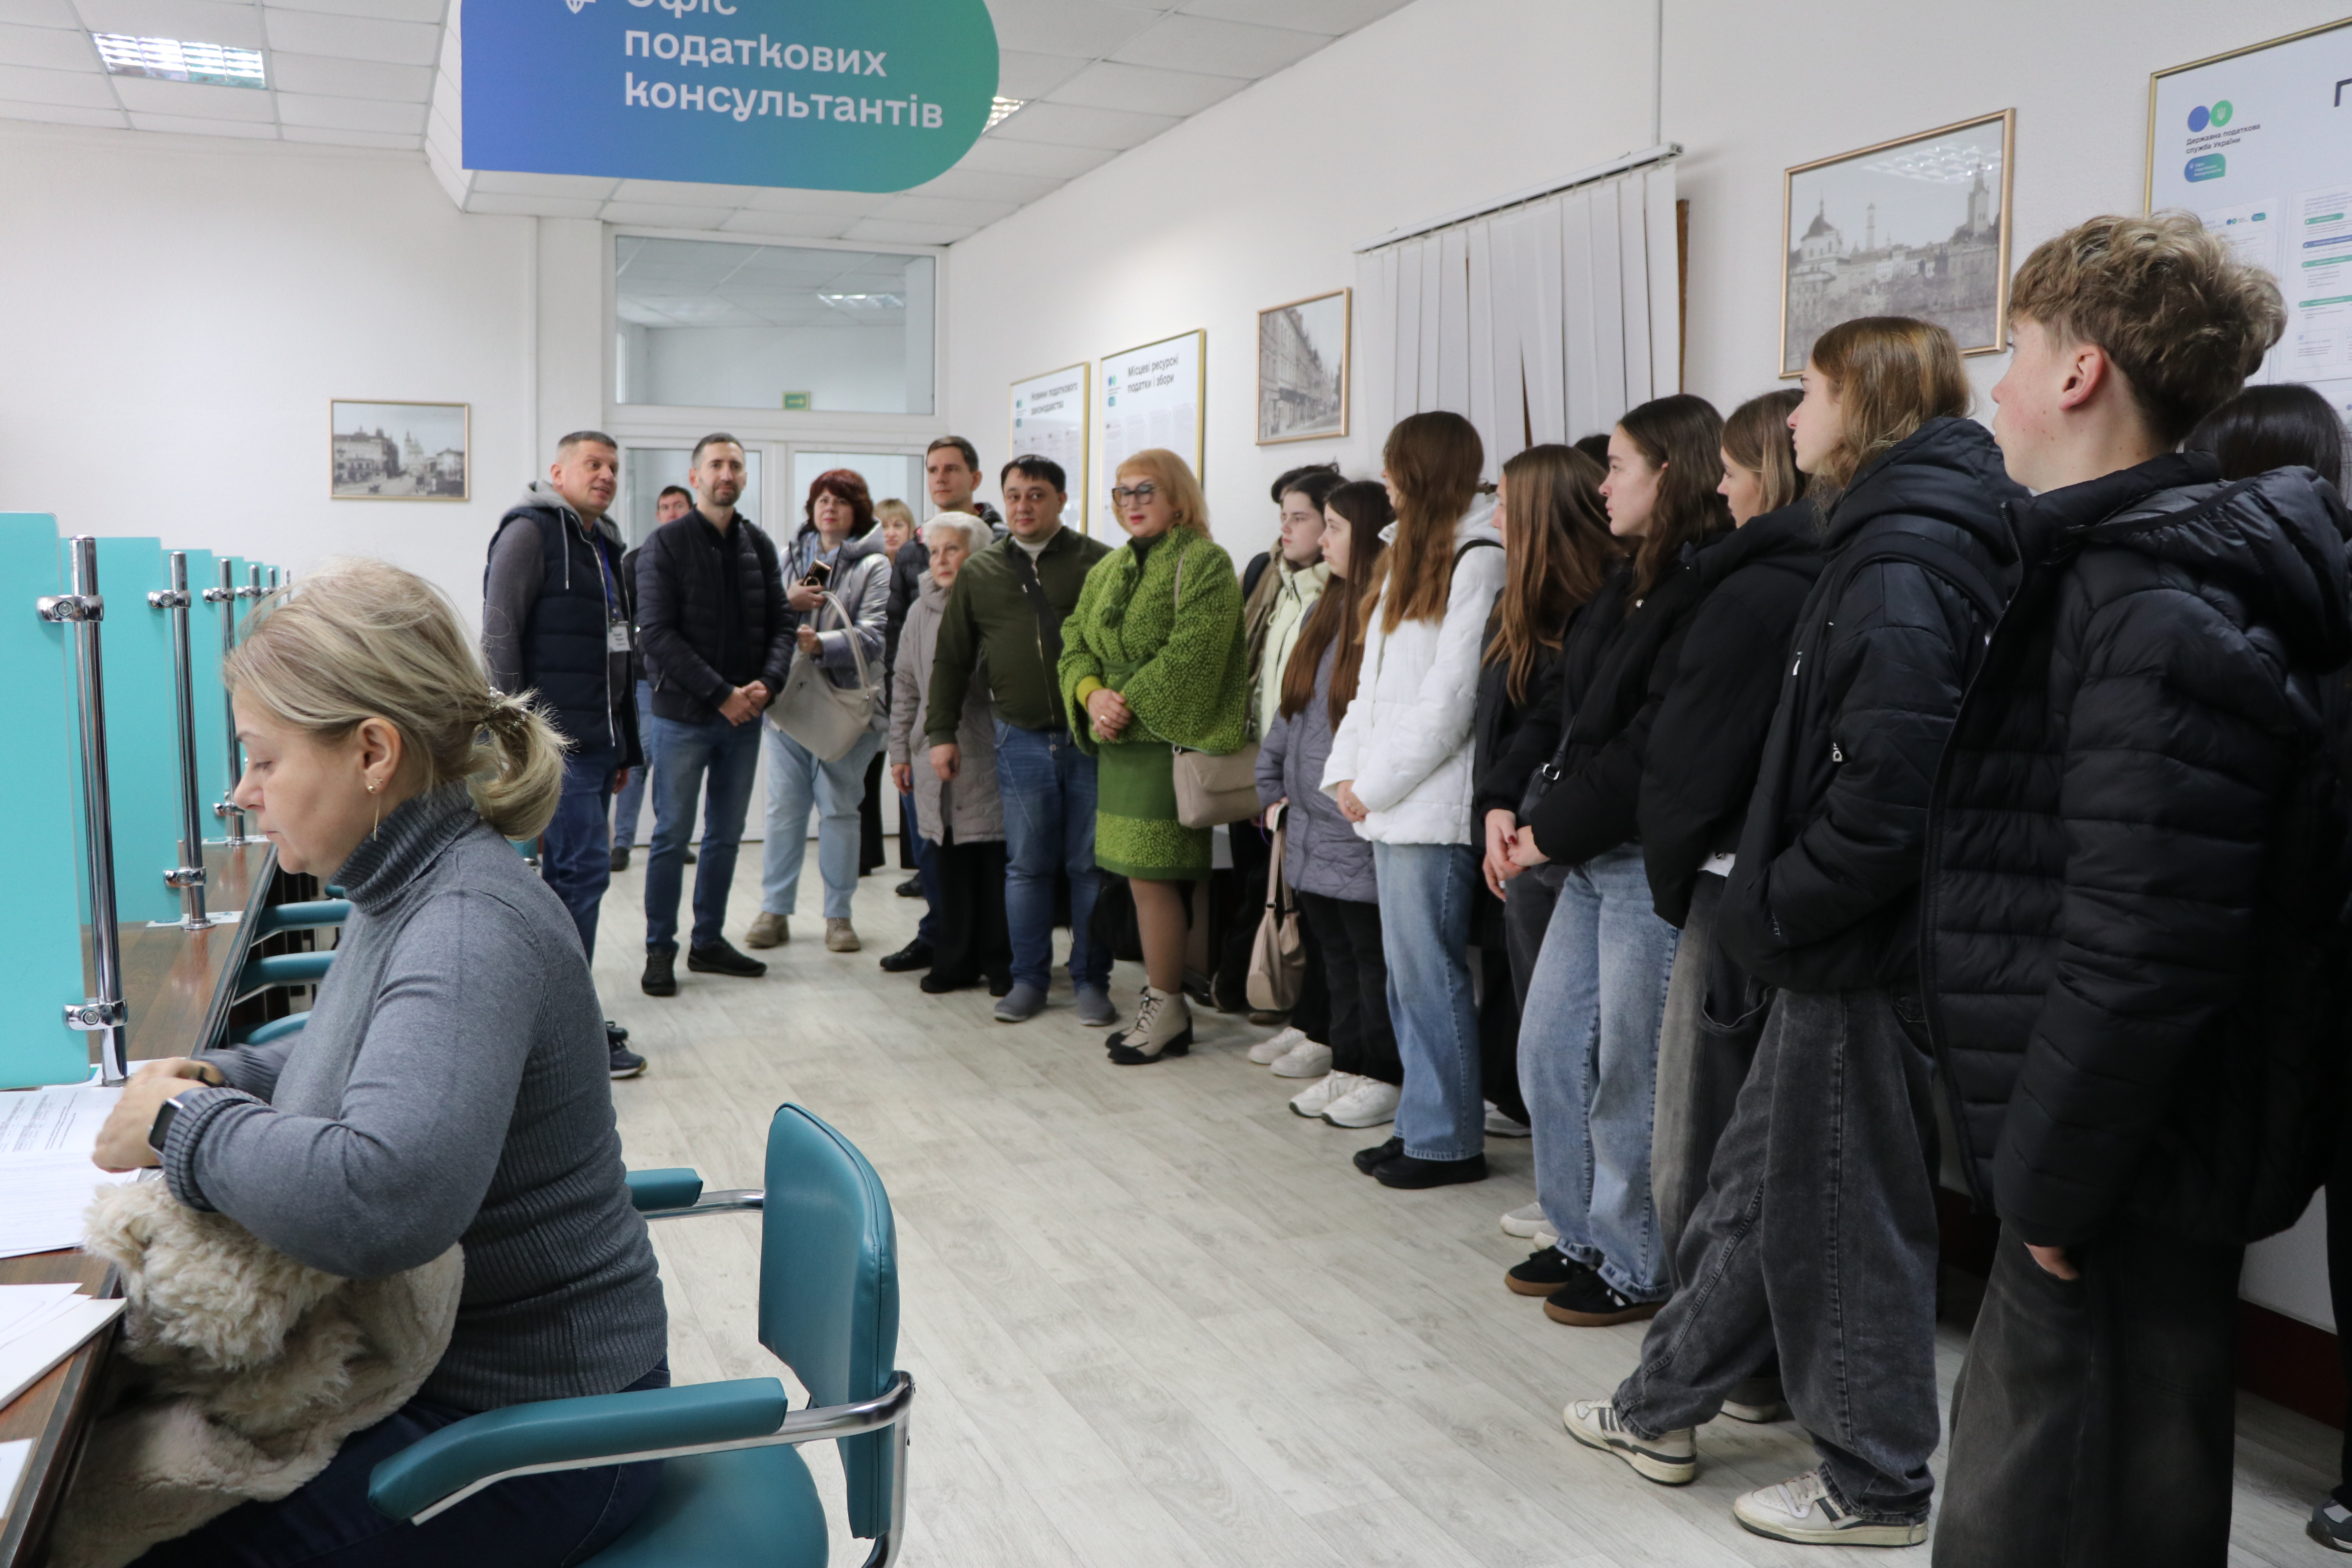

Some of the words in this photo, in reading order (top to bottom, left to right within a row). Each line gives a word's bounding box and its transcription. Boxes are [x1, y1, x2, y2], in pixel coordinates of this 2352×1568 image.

[626, 29, 887, 78] податкових
[625, 72, 943, 129] консультантів
[2186, 143, 2211, 153] служба
[2214, 138, 2240, 147] України
[2187, 133, 2221, 145] Державна
[2223, 124, 2260, 136] податкова
[1128, 361, 1151, 377] Місцеві
[1152, 353, 1179, 372] ресурсні
[1128, 380, 1152, 393] податки
[1156, 374, 1174, 387] збори
